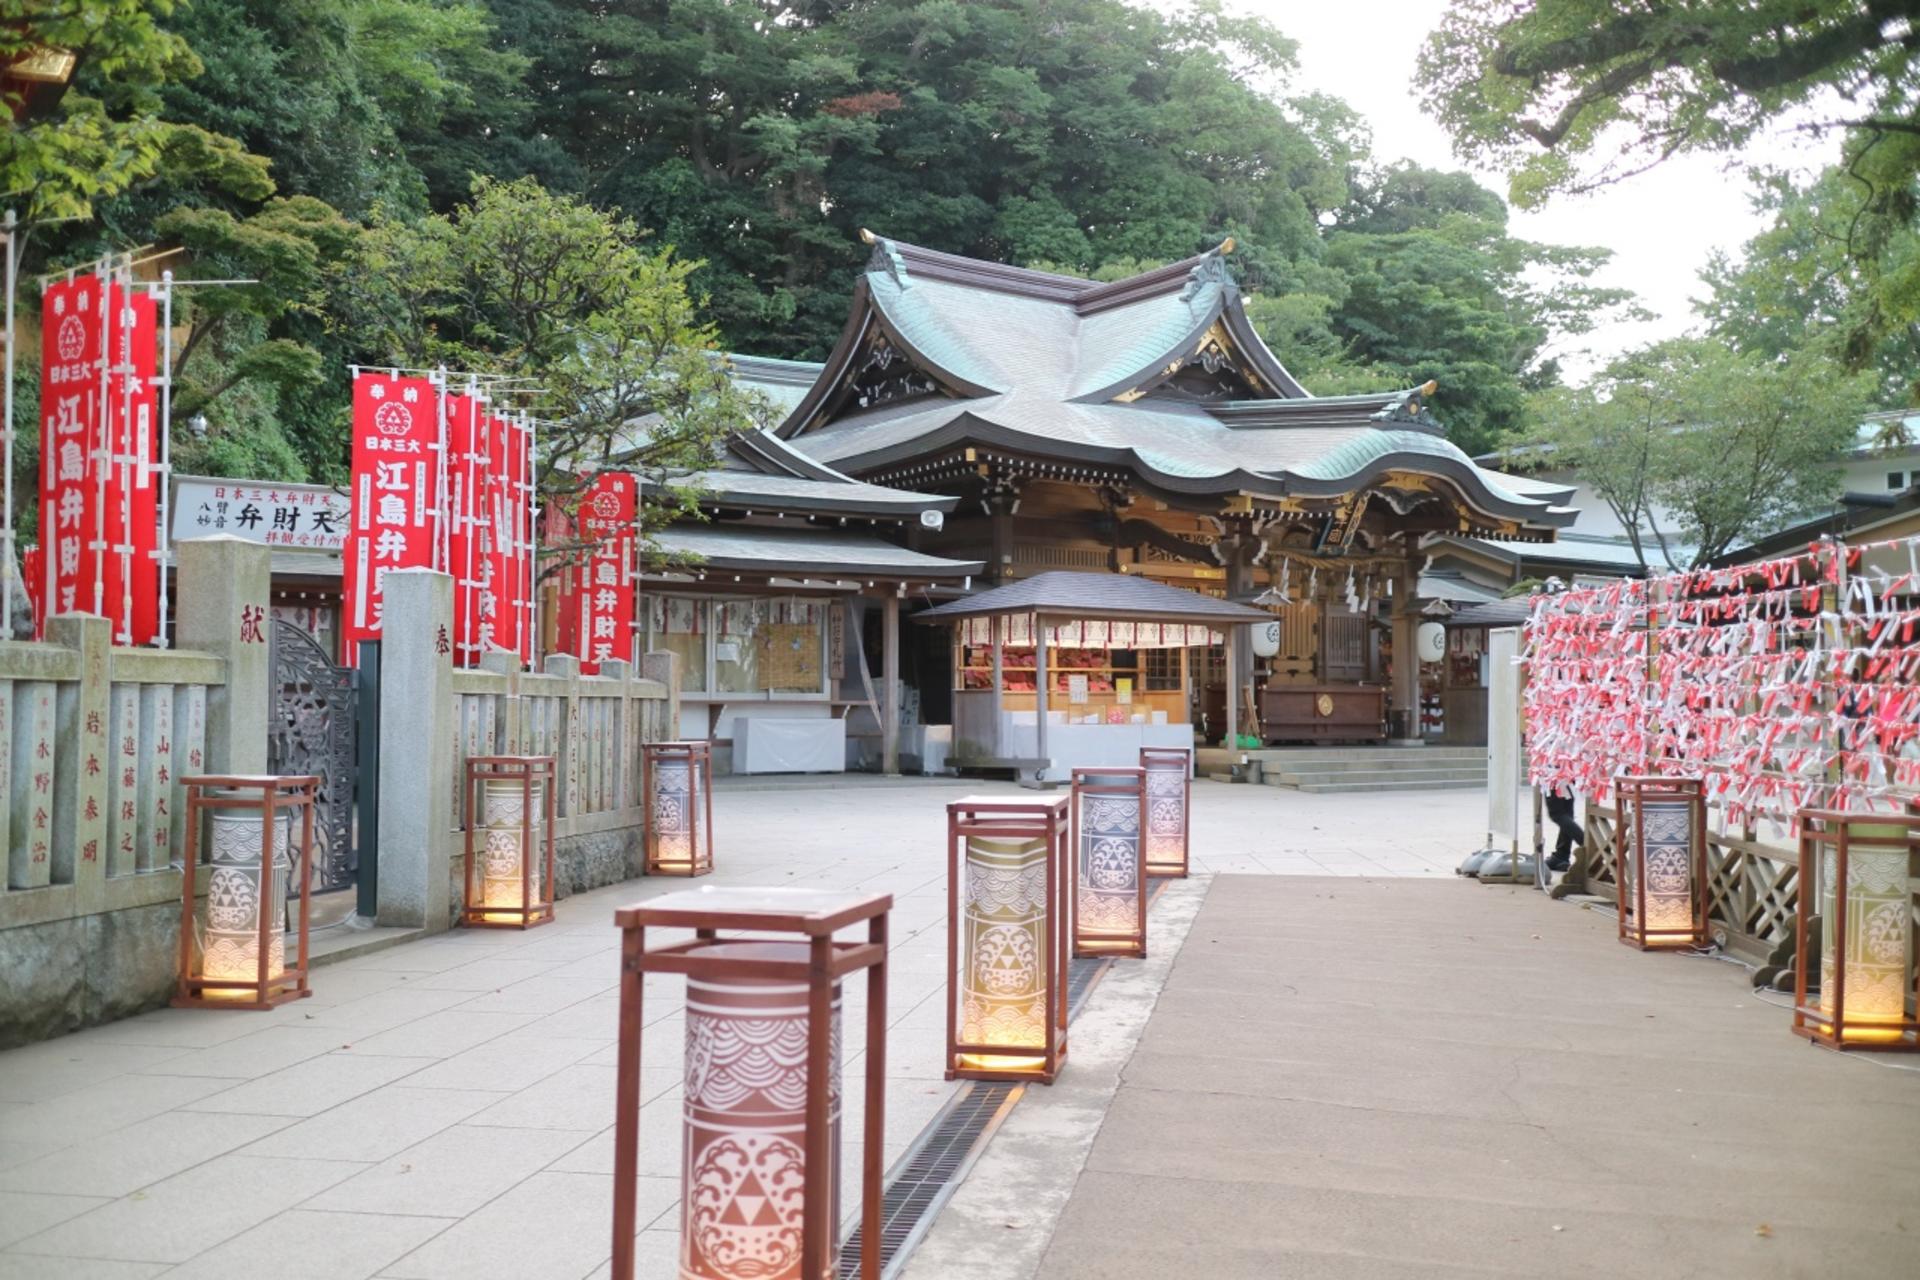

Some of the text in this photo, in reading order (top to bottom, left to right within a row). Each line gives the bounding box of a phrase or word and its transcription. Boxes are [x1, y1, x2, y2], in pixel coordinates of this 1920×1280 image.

[51, 361, 92, 384] 日本三大
[366, 436, 421, 454] 日本三大
[57, 394, 85, 618] 江島弁財天
[214, 486, 333, 507] 日本三大弁財天
[196, 514, 229, 529] 妙音
[235, 503, 336, 534] 弁財天
[265, 530, 342, 547] 拝観受付所
[369, 459, 410, 632] 江島弁
[591, 536, 619, 665] 江島弁財天
[240, 604, 265, 645] 献
[435, 623, 451, 657] 奉
